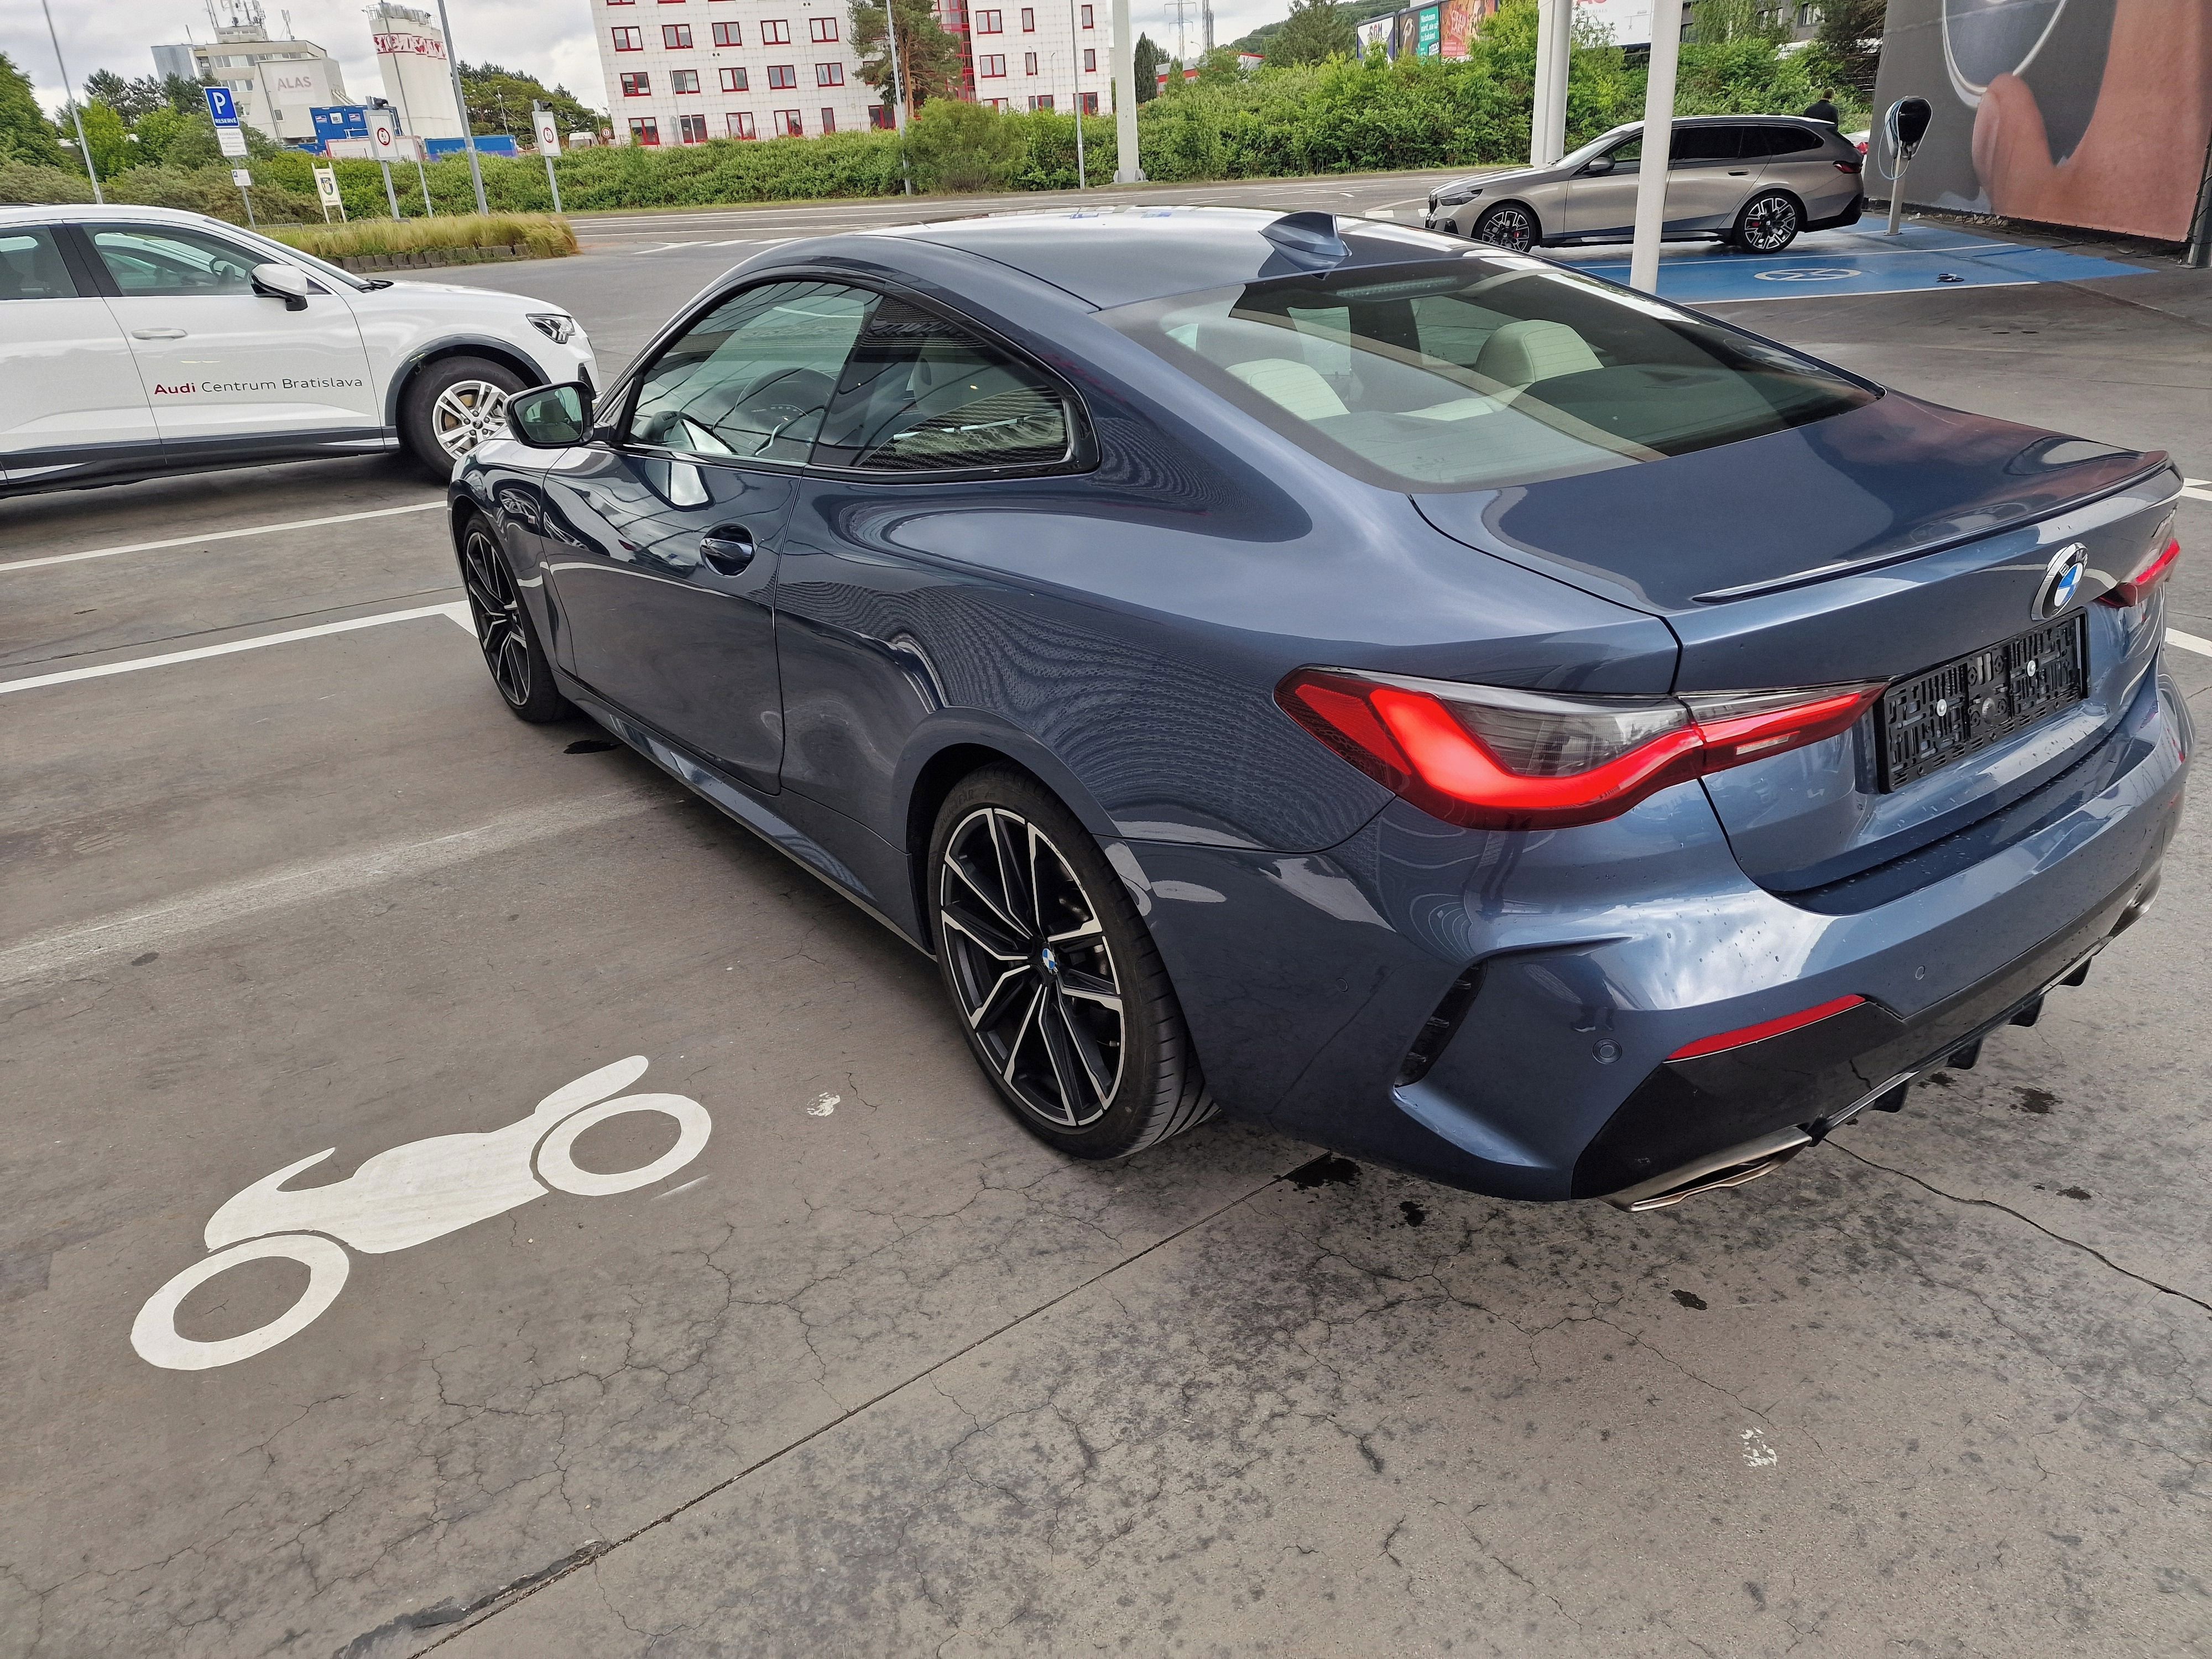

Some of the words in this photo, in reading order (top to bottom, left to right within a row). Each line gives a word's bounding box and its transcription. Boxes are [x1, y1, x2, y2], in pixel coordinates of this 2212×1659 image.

[278, 76, 312, 91] ALAS
[212, 92, 226, 114] P
[154, 383, 196, 395] Audi
[201, 380, 276, 393] Centrum
[282, 377, 363, 389] Bratislava
